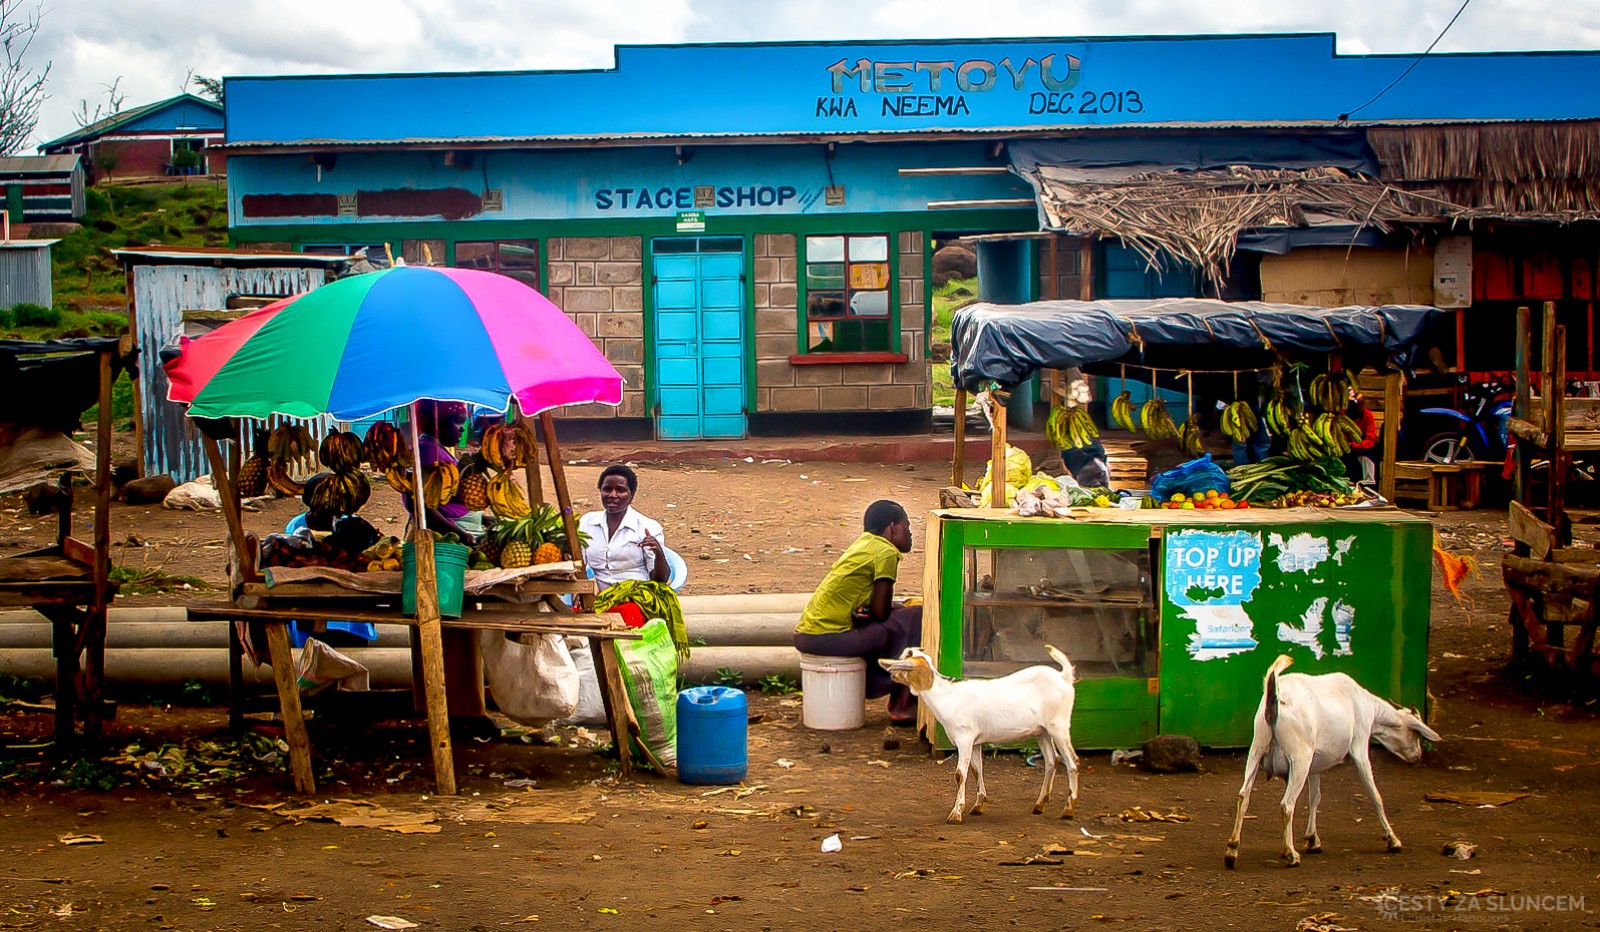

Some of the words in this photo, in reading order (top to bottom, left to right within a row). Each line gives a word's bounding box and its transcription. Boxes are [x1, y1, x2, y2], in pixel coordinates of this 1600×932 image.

[826, 53, 1081, 93] METOYU
[815, 96, 858, 118] KWA
[881, 95, 970, 116] NEEMA
[716, 186, 797, 207] SHOP
[1174, 547, 1220, 568] TOP
[1227, 548, 1256, 568] UP
